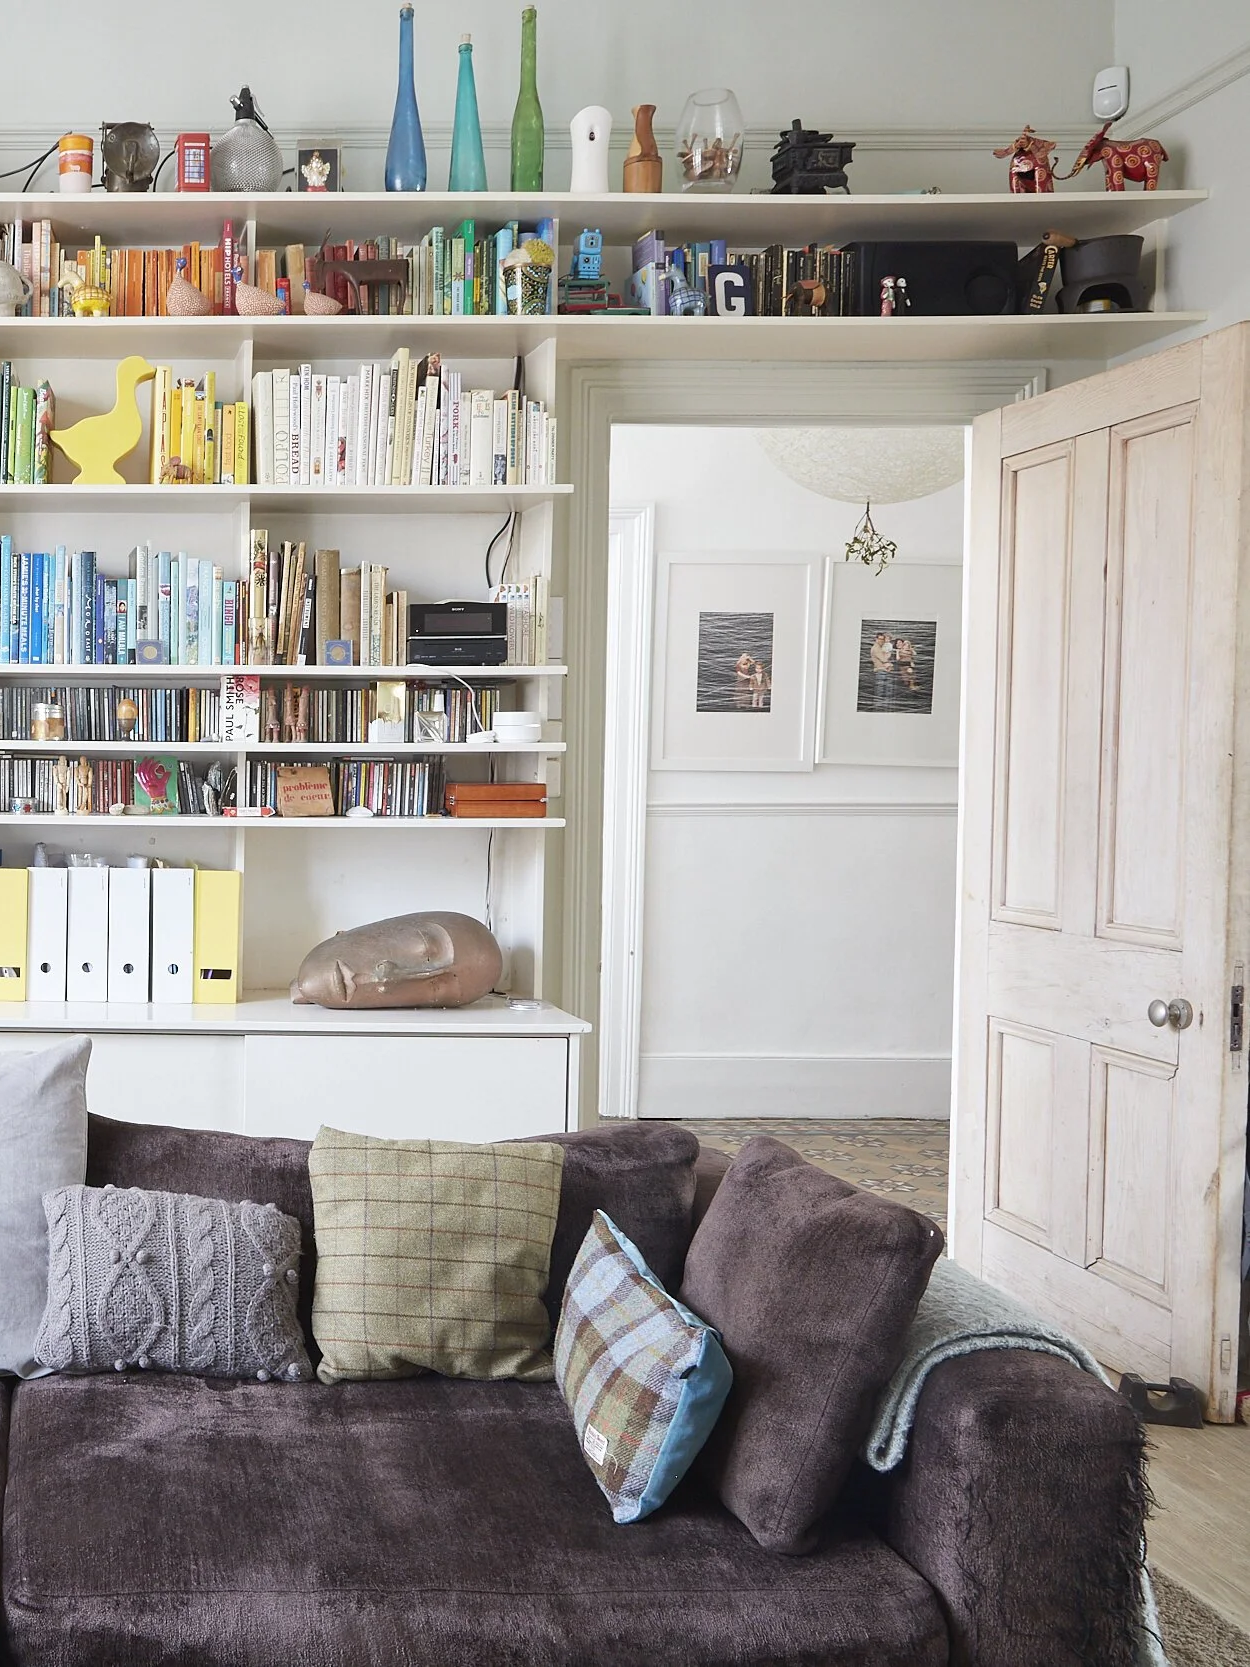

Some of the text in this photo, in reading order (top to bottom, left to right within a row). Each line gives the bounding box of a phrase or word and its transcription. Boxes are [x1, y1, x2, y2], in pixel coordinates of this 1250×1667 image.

[1044, 245, 1058, 269] CARTER
[714, 272, 745, 316] G
[292, 396, 300, 431] Hollywood's
[237, 434, 245, 461] Found
[291, 433, 299, 474] BREAD
[423, 431, 434, 464] Turkey
[20, 555, 29, 653] JAMIE'S MEALS
[224, 598, 235, 626] BINGO
[117, 631, 126, 655] MALALA
[235, 676, 245, 705] ROSE
[225, 676, 235, 742] PAUL SMITH
